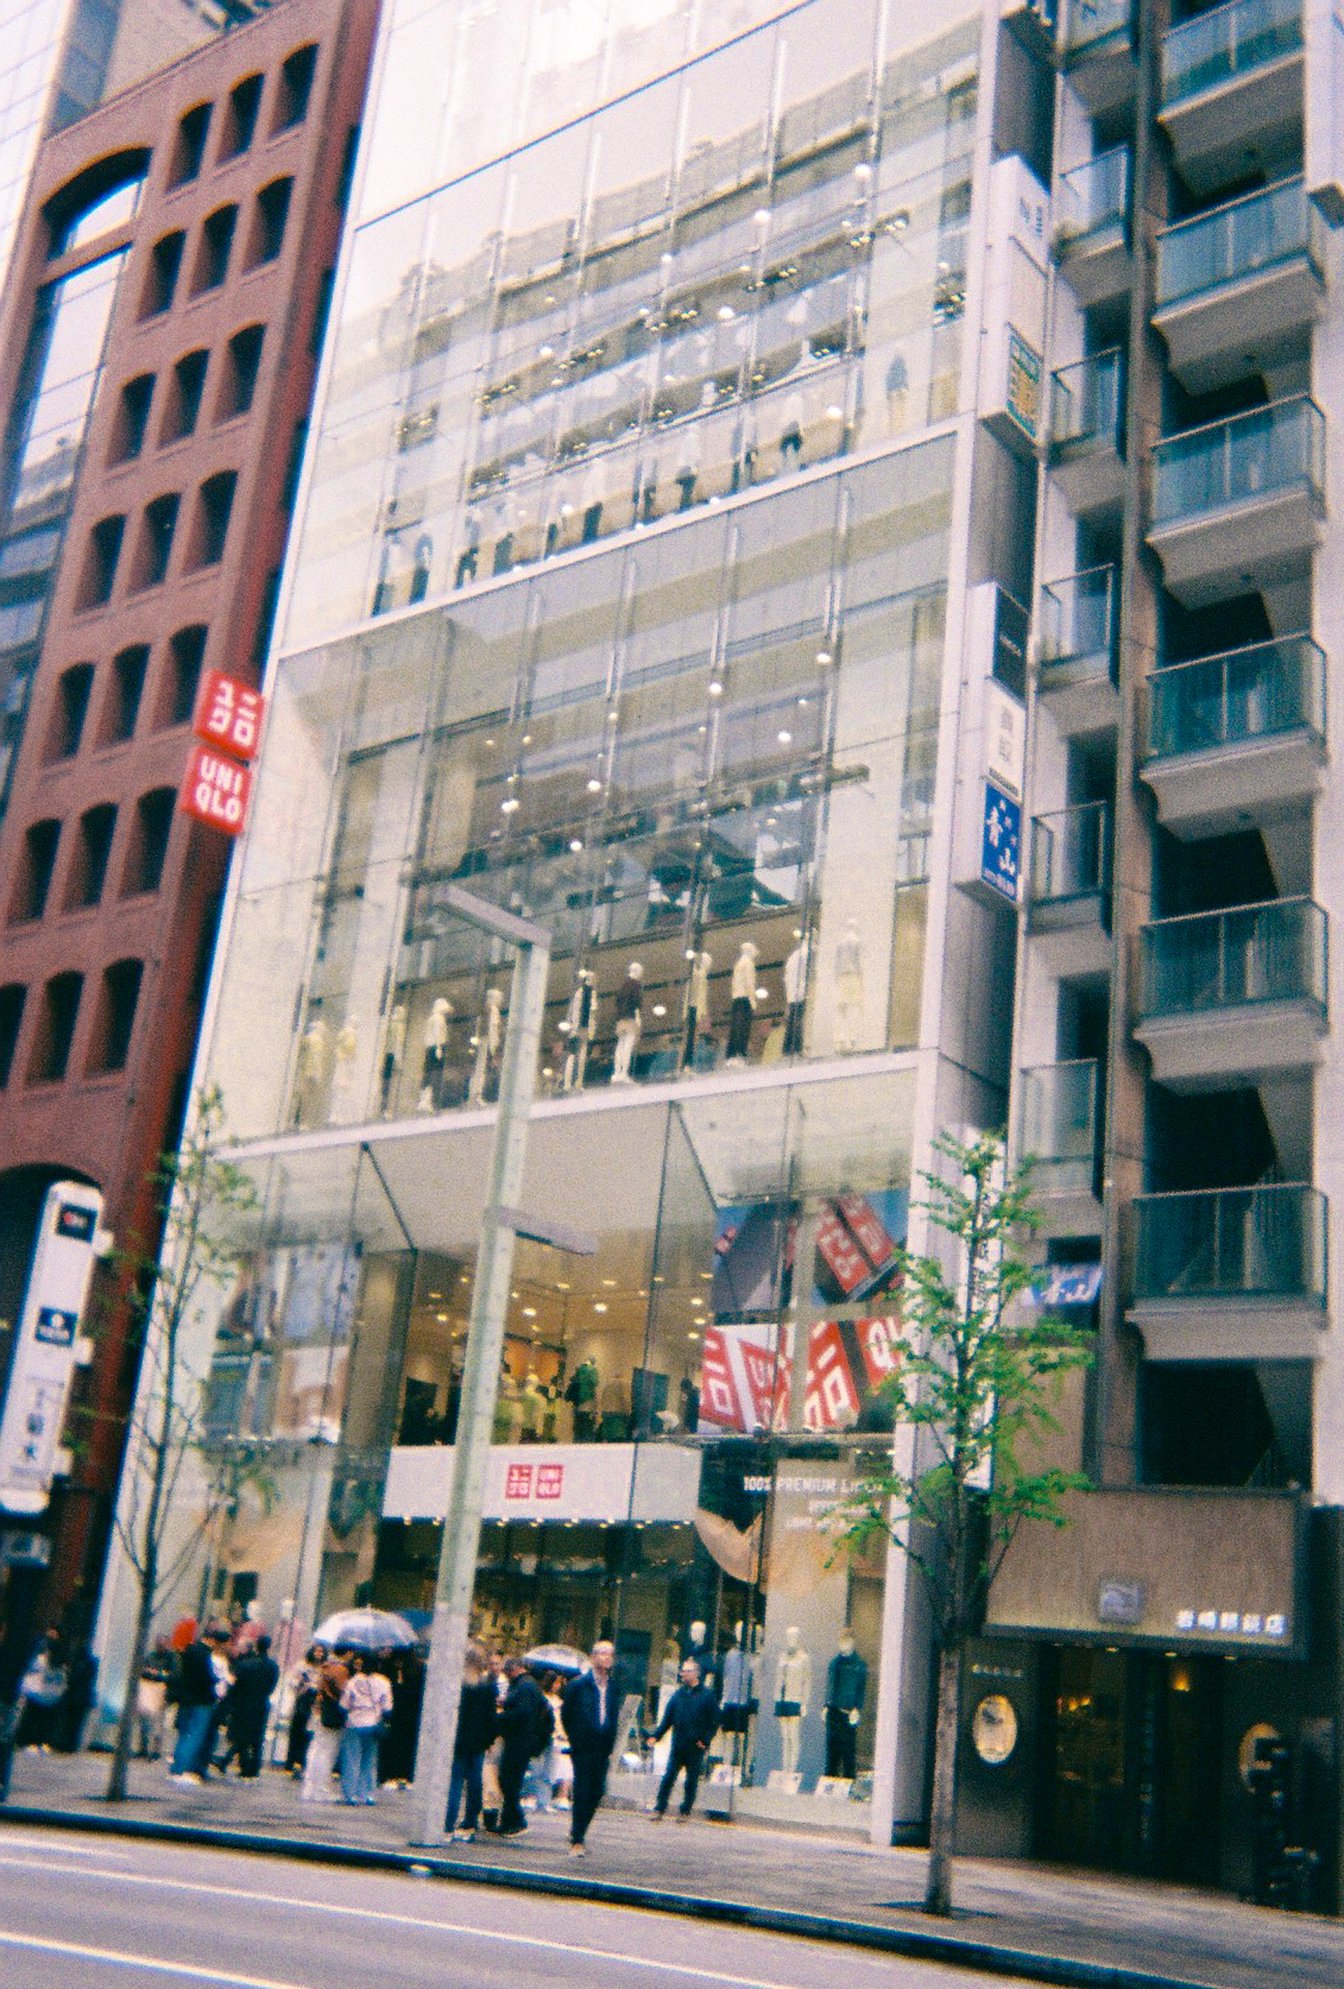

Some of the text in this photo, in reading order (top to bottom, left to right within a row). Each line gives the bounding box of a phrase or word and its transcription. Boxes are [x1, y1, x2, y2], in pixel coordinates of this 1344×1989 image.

[199, 755, 243, 796] UNI
[195, 781, 241, 823] QLO
[775, 1476, 837, 1493] PREMIUM
